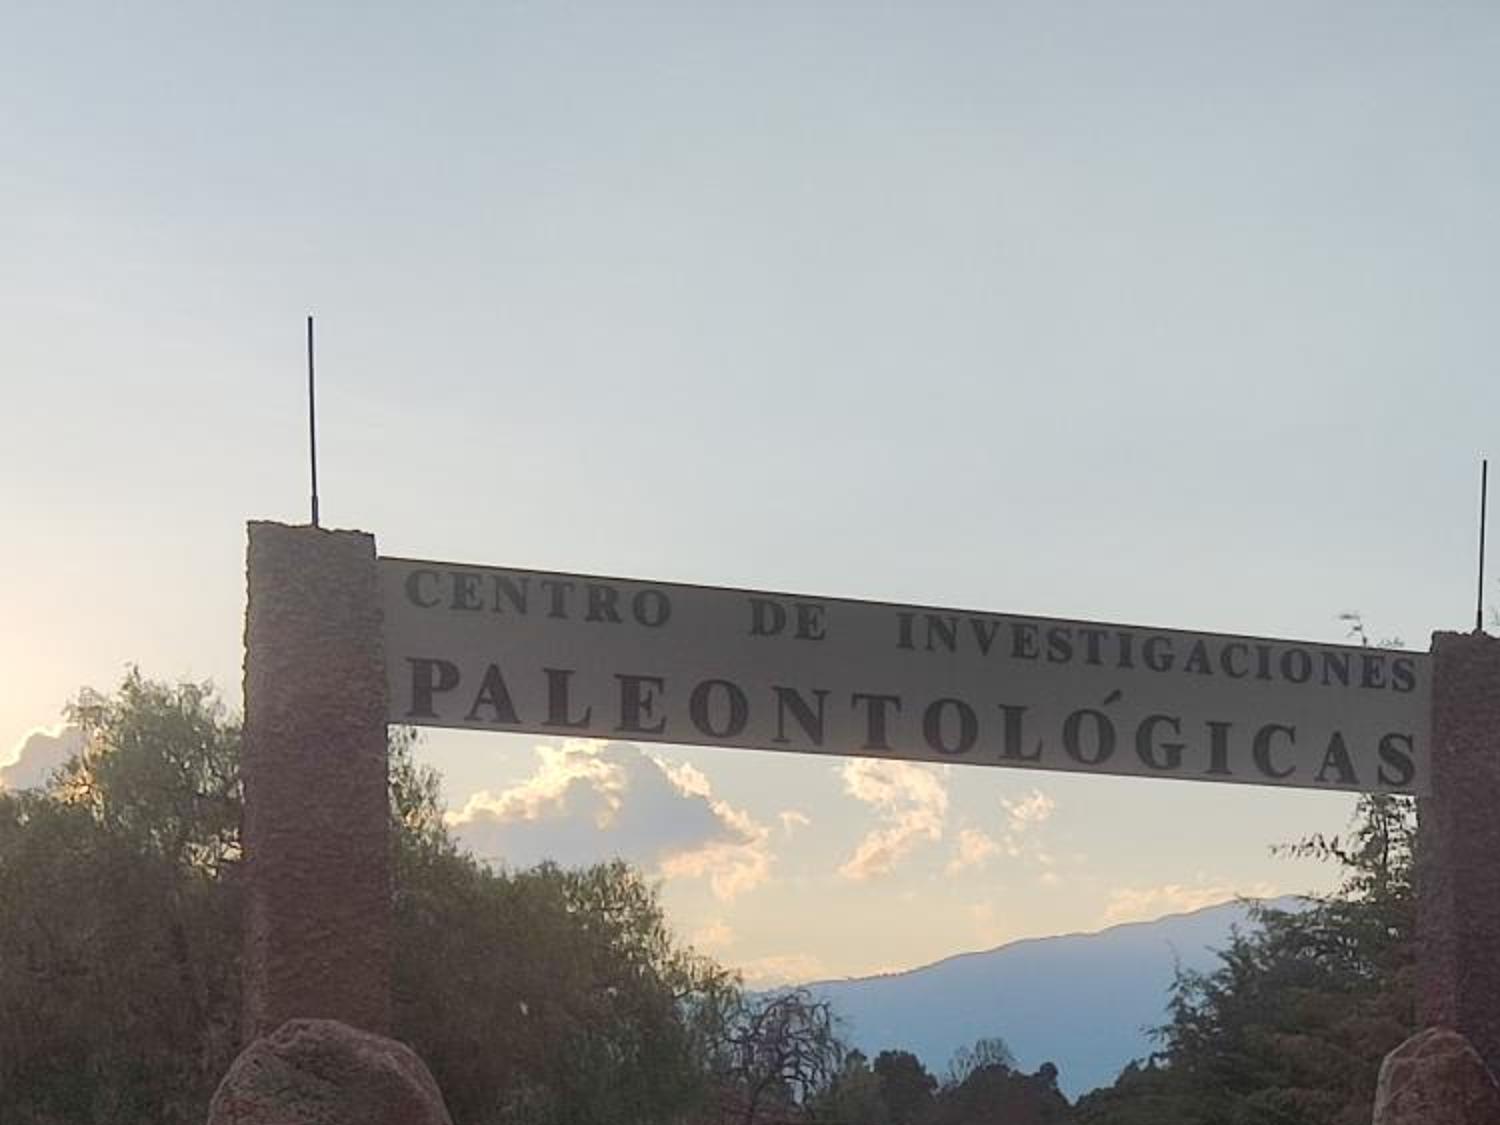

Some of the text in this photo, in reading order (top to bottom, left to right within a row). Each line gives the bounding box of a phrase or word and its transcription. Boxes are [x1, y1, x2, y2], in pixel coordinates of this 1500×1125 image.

[404, 569, 1416, 693] CENTRO DE INVESTIGACIONES
[404, 657, 1416, 786] PALEONTOLÓGICAS
